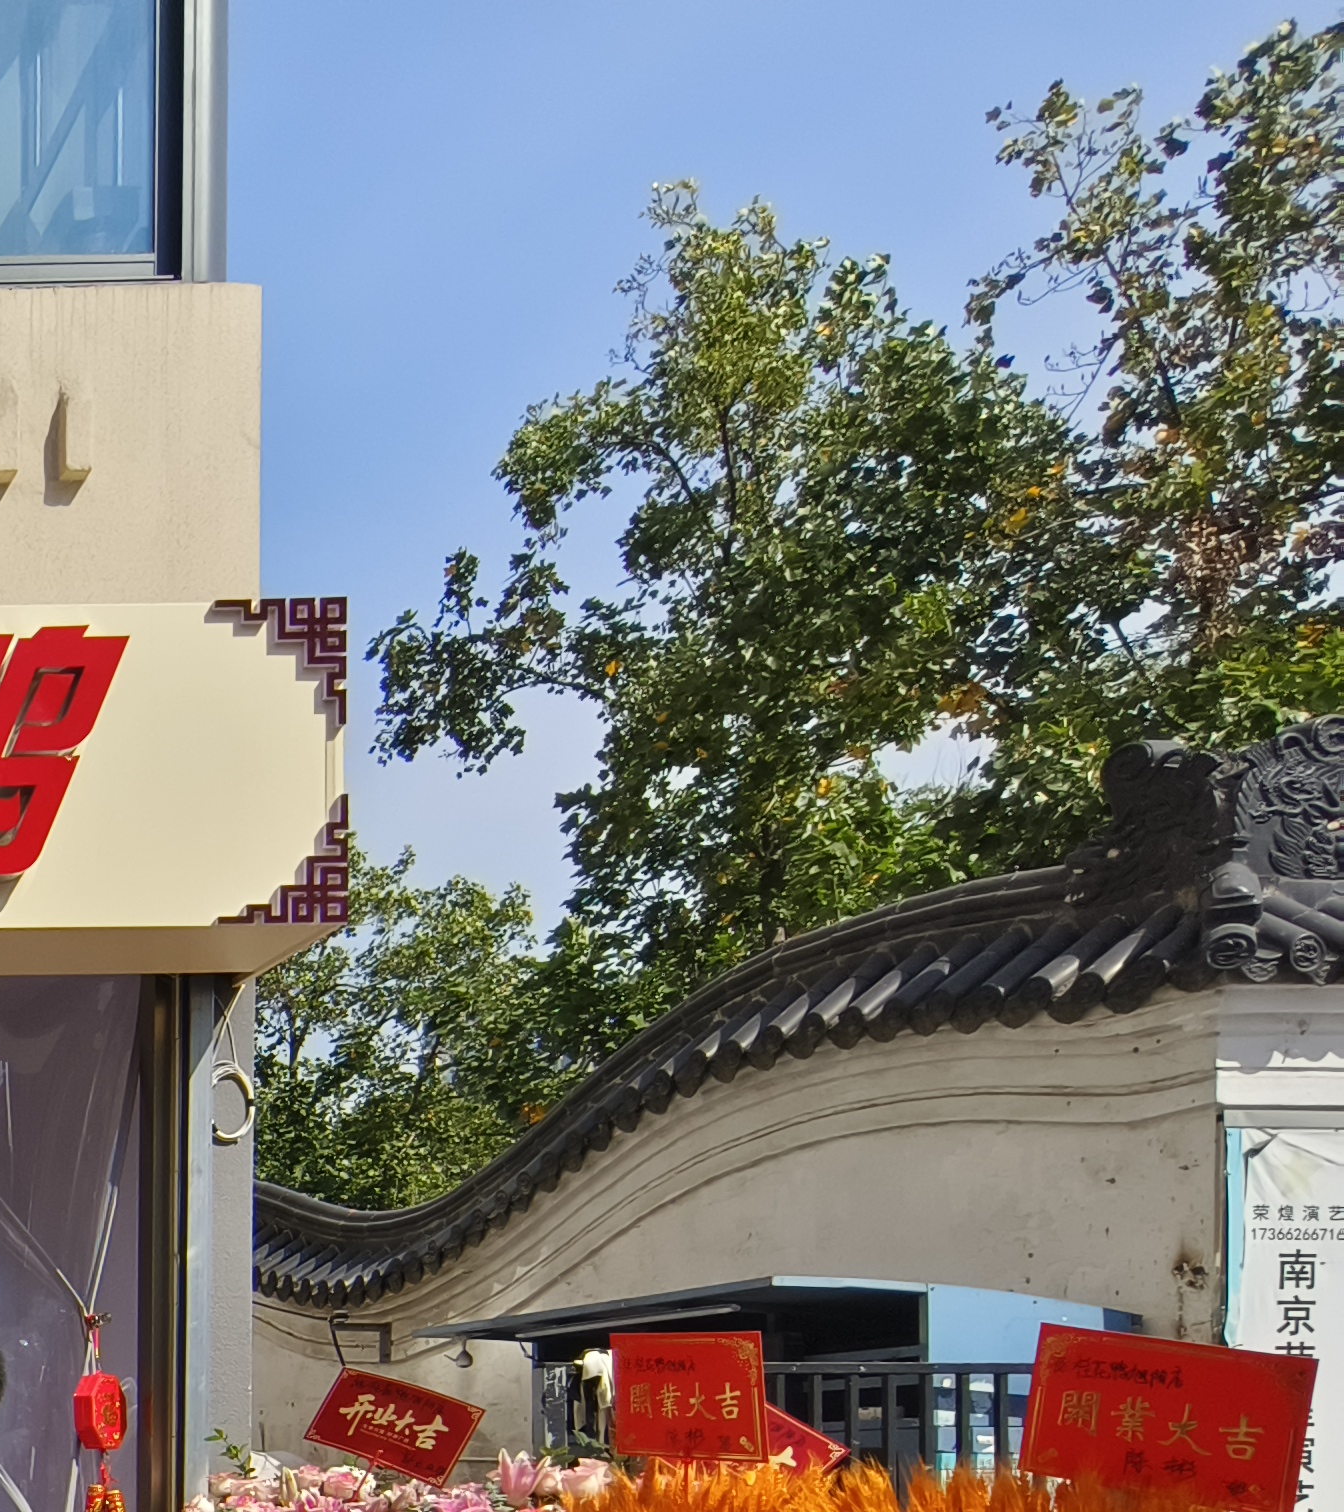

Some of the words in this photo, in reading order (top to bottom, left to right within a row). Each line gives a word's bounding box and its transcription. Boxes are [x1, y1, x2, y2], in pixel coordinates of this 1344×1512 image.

[338, 1393, 450, 1450] 开业大吉
[629, 1381, 742, 1420] 開業大吉
[1057, 1389, 1265, 1461] 開業大吉
